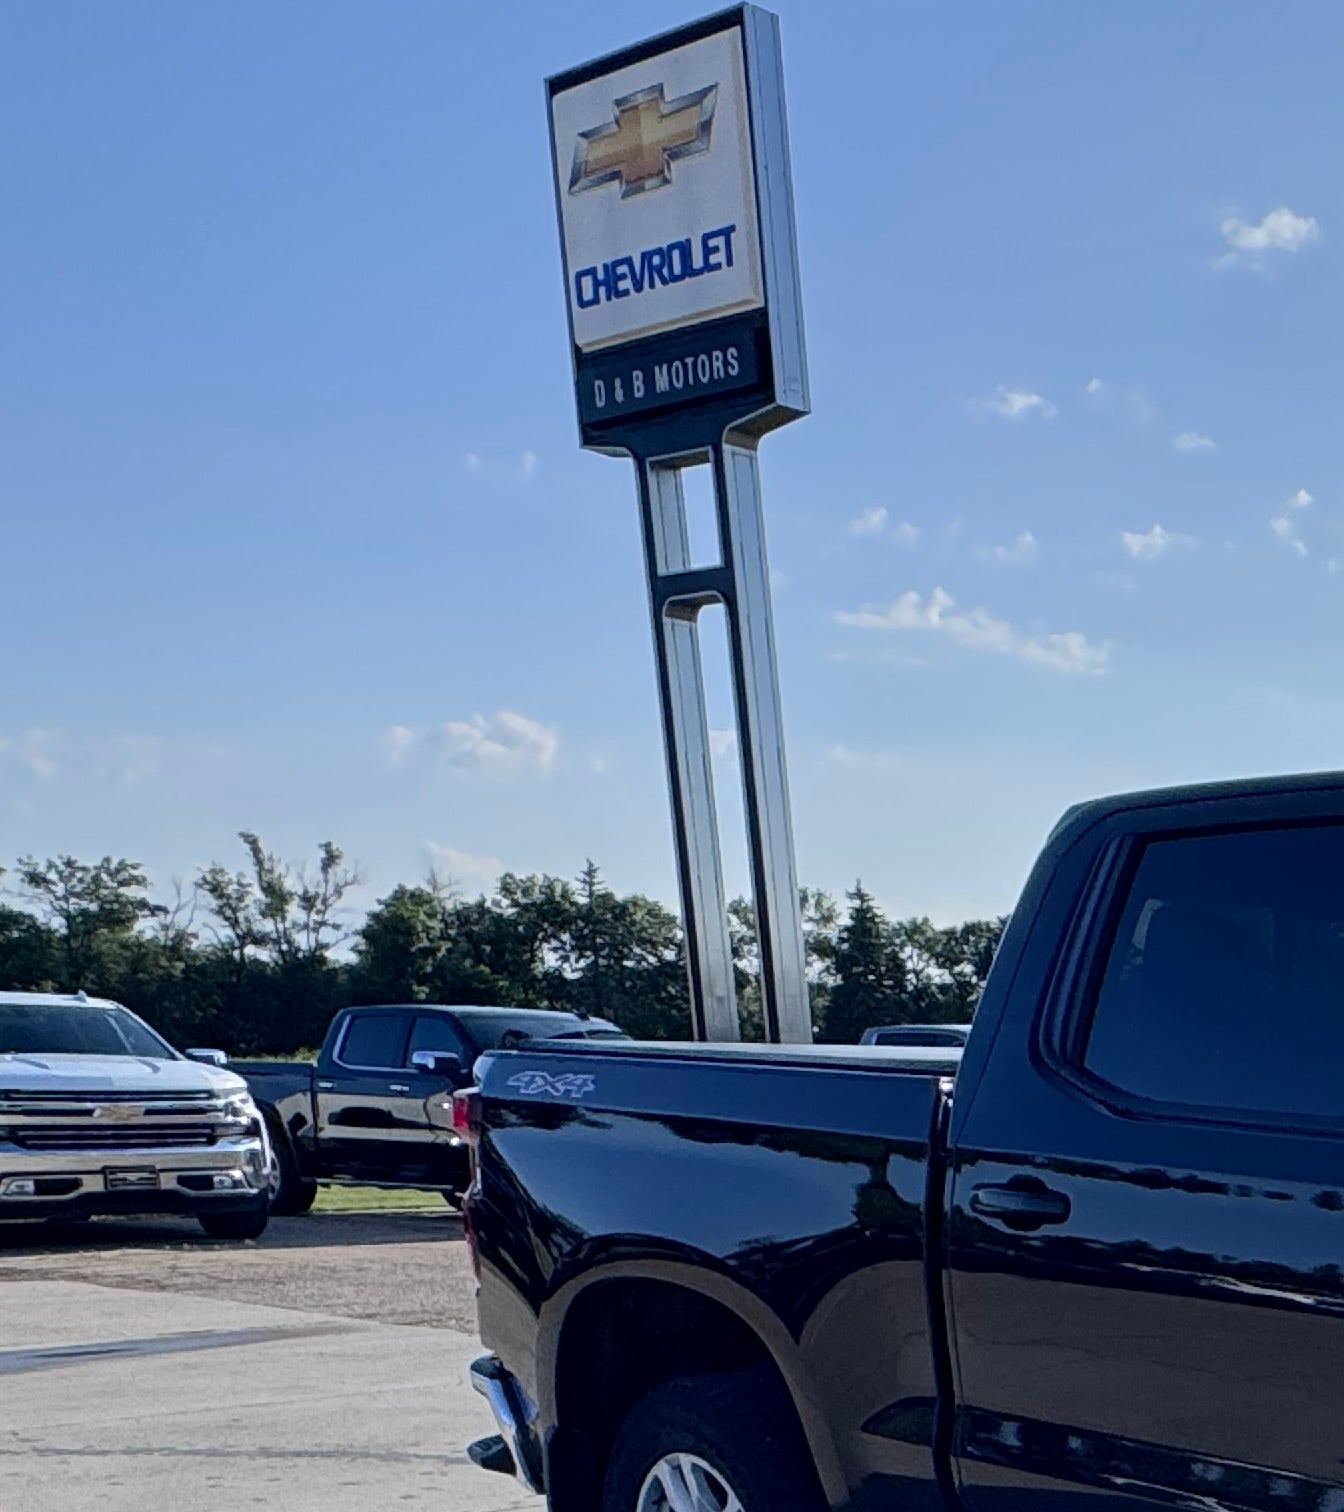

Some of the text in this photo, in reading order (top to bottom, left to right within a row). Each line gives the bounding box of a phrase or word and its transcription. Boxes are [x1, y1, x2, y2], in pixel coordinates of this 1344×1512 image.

[574, 224, 737, 310] CHEVROLET
[594, 346, 741, 409] D & B MOTORS
